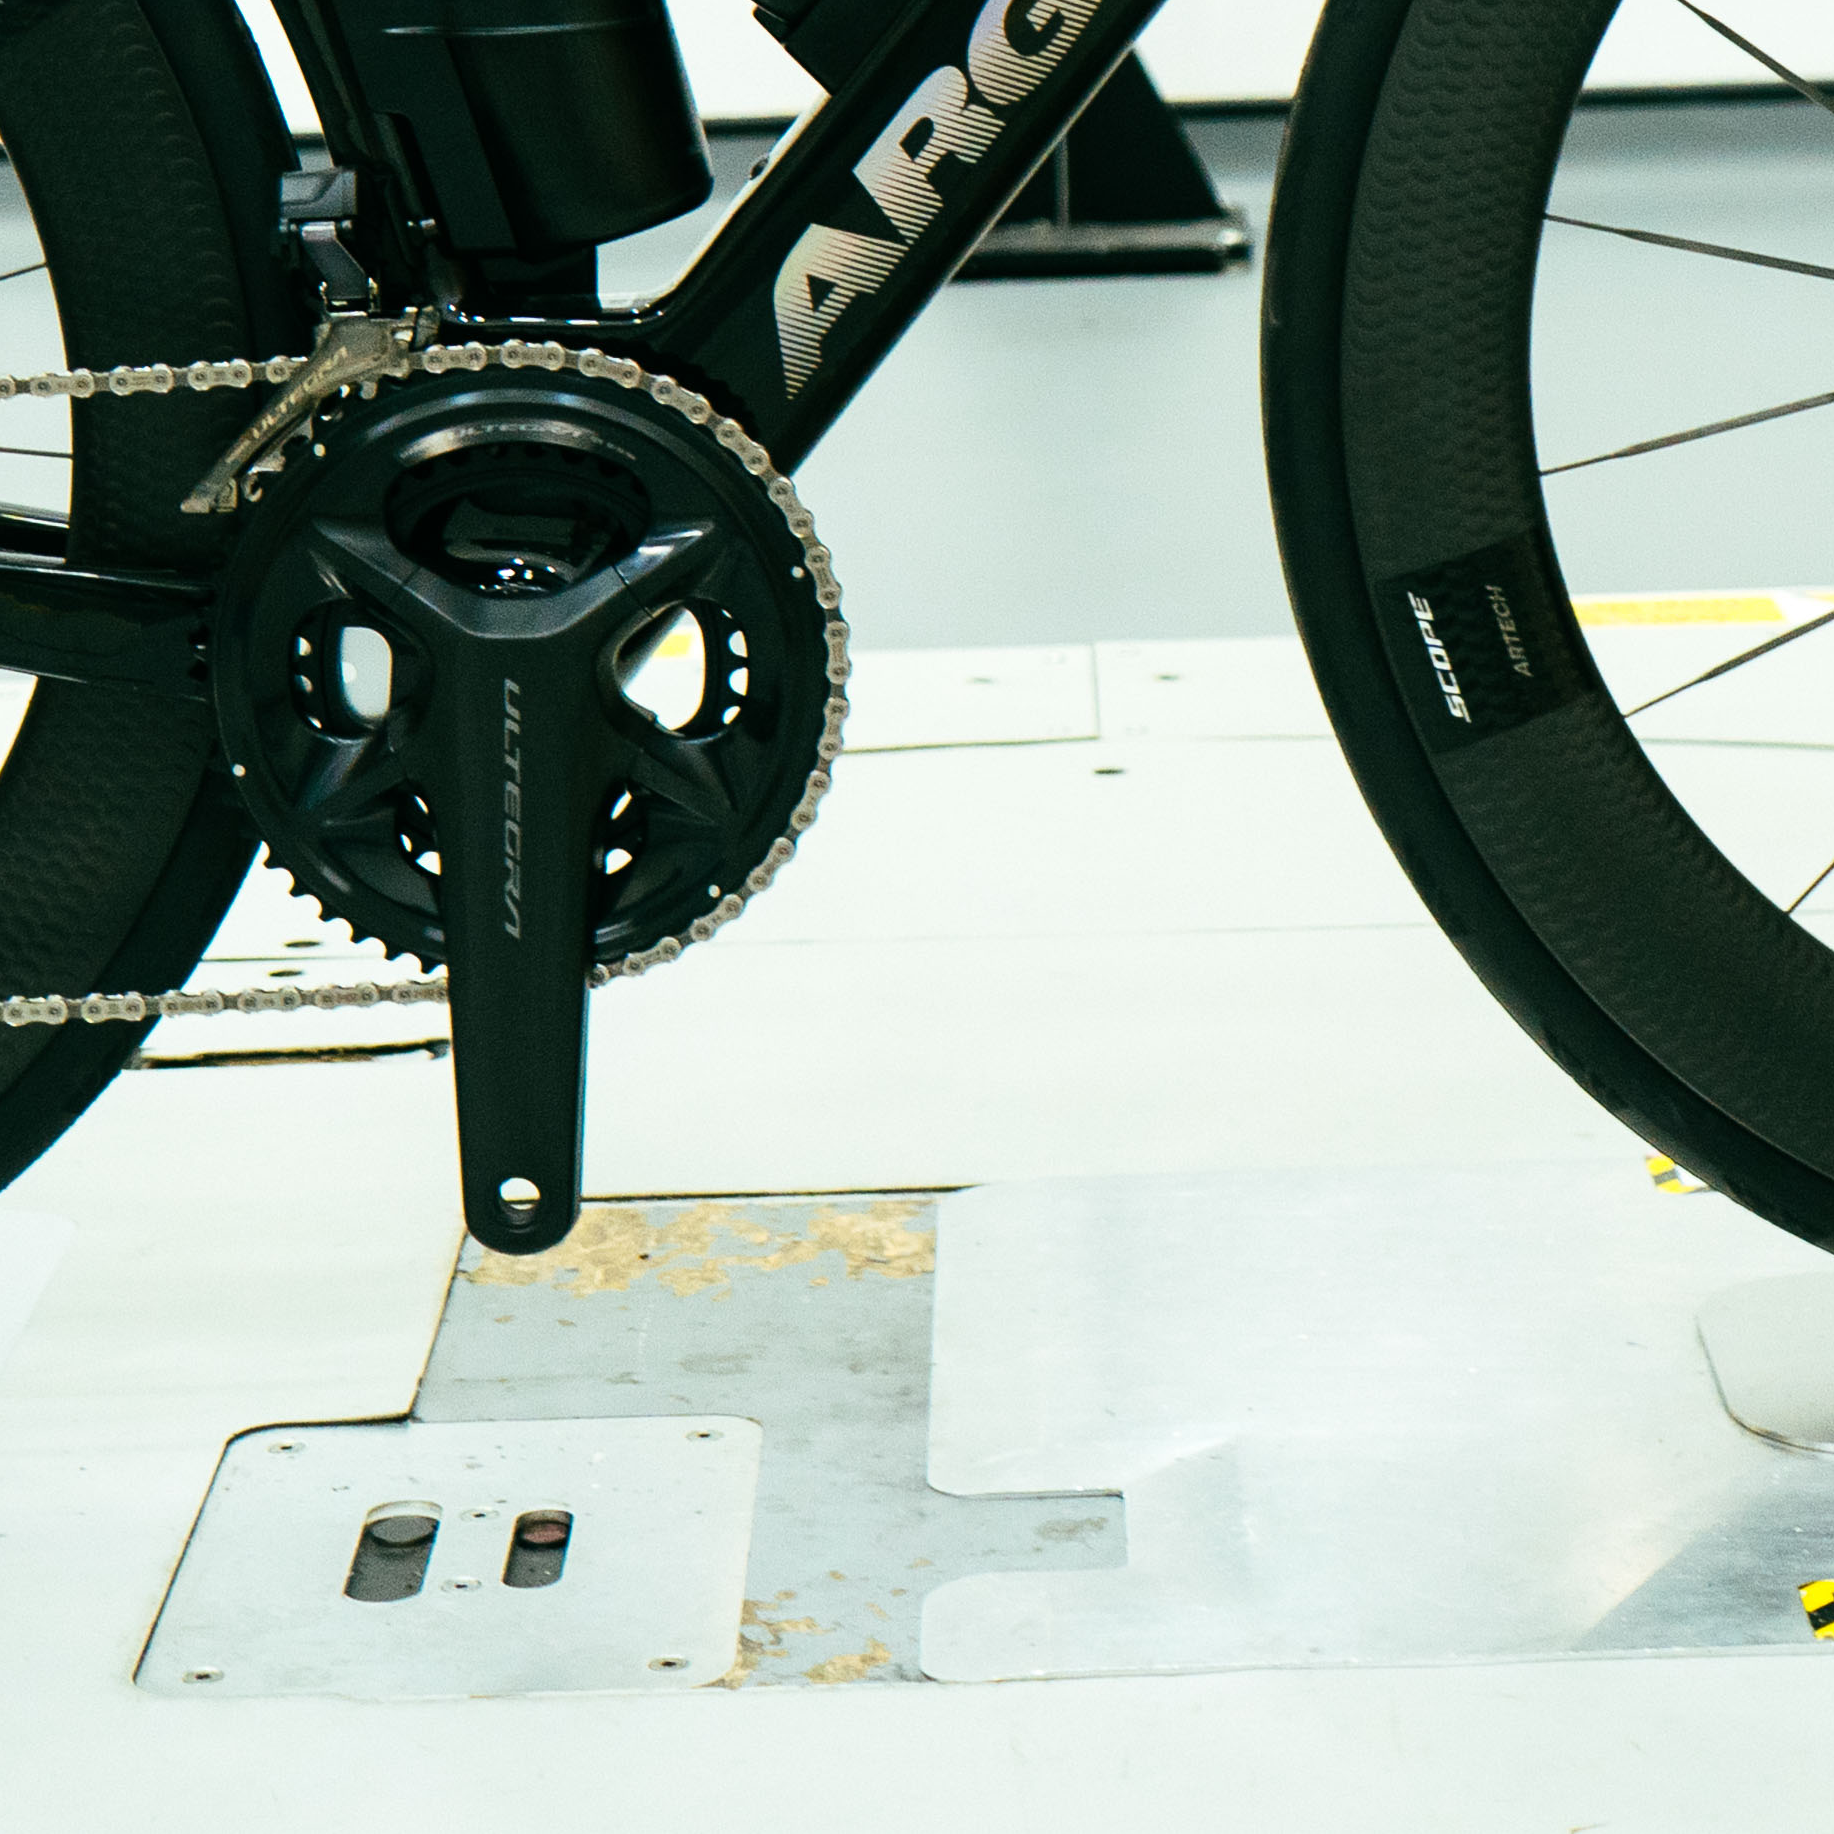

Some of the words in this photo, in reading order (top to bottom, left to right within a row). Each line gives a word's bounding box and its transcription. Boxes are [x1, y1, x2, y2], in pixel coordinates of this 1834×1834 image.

[1407, 591, 1472, 724] SCOPE
[1485, 584, 1534, 677] ARTECH
[503, 677, 522, 940] ULTEGRA
